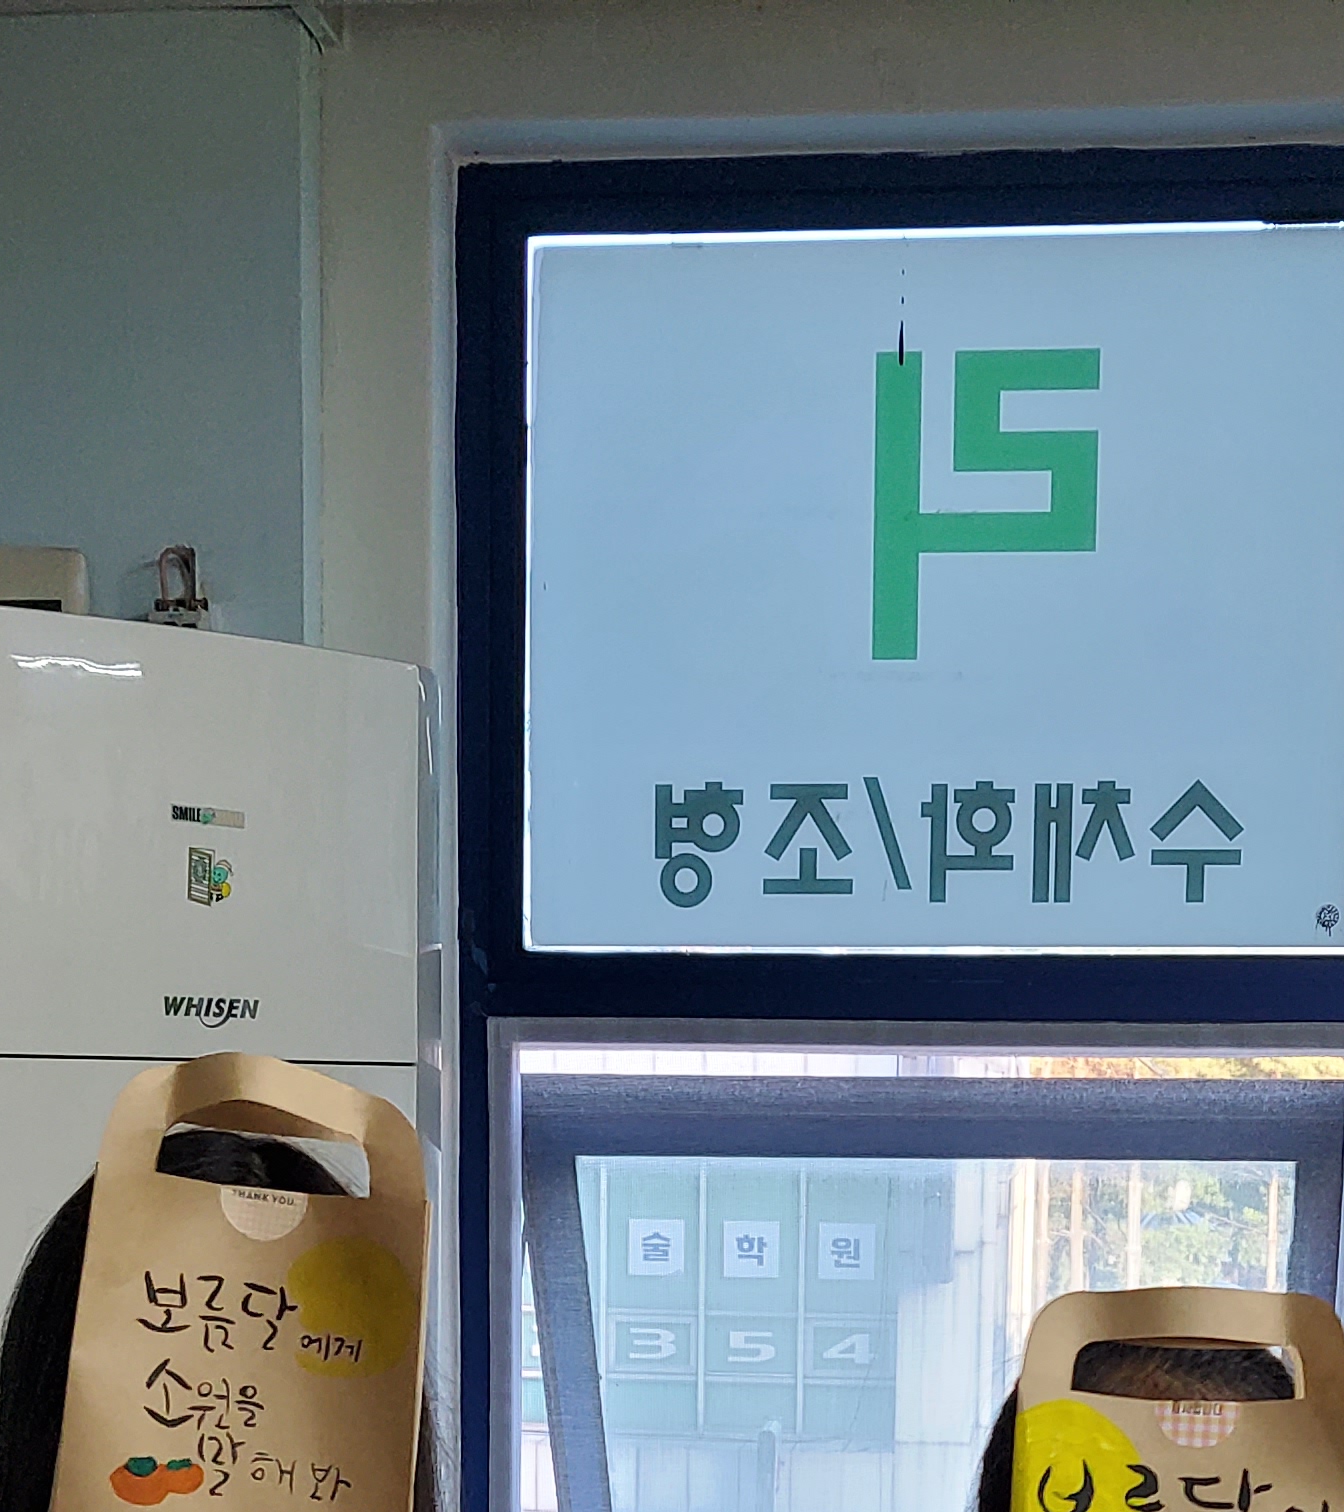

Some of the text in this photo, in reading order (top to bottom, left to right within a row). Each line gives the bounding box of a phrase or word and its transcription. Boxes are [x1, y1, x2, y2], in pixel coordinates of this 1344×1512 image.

[172, 805, 202, 823] SMILE
[163, 996, 260, 1026] WHISEN
[232, 1189, 295, 1206] THANK YOU
[628, 1327, 875, 1365] 3 5 4
[144, 1358, 264, 1429] 소원을
